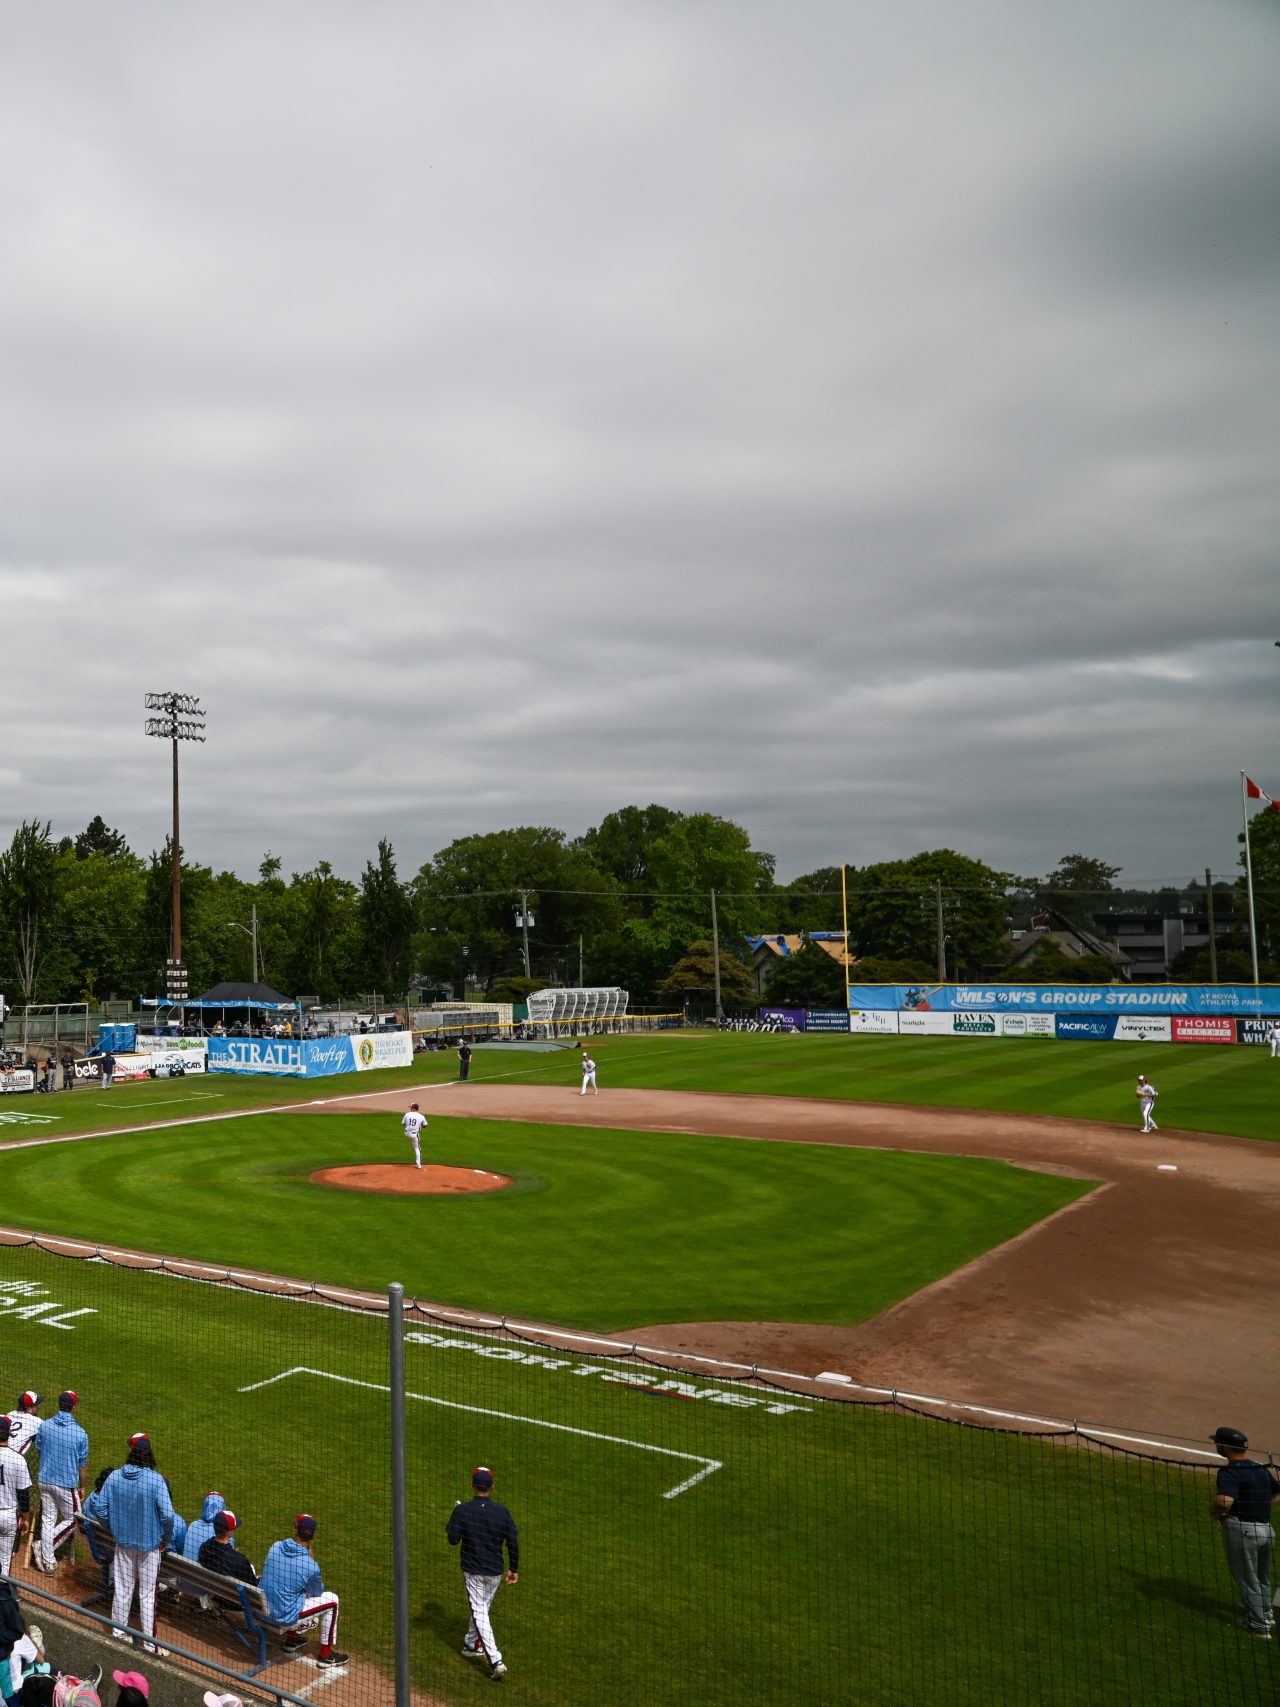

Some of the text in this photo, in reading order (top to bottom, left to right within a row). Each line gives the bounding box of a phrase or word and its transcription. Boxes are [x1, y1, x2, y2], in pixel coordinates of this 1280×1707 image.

[1041, 992, 1102, 1004] GROUP
[1105, 993, 1188, 1005] STADIUM
[953, 1014, 996, 1024] RAVEN
[1176, 1019, 1230, 1028] THOMIS
[211, 1042, 301, 1066] THE STRATH
[409, 1118, 417, 1127] 19
[406, 1332, 814, 1415] SPORTSNET
